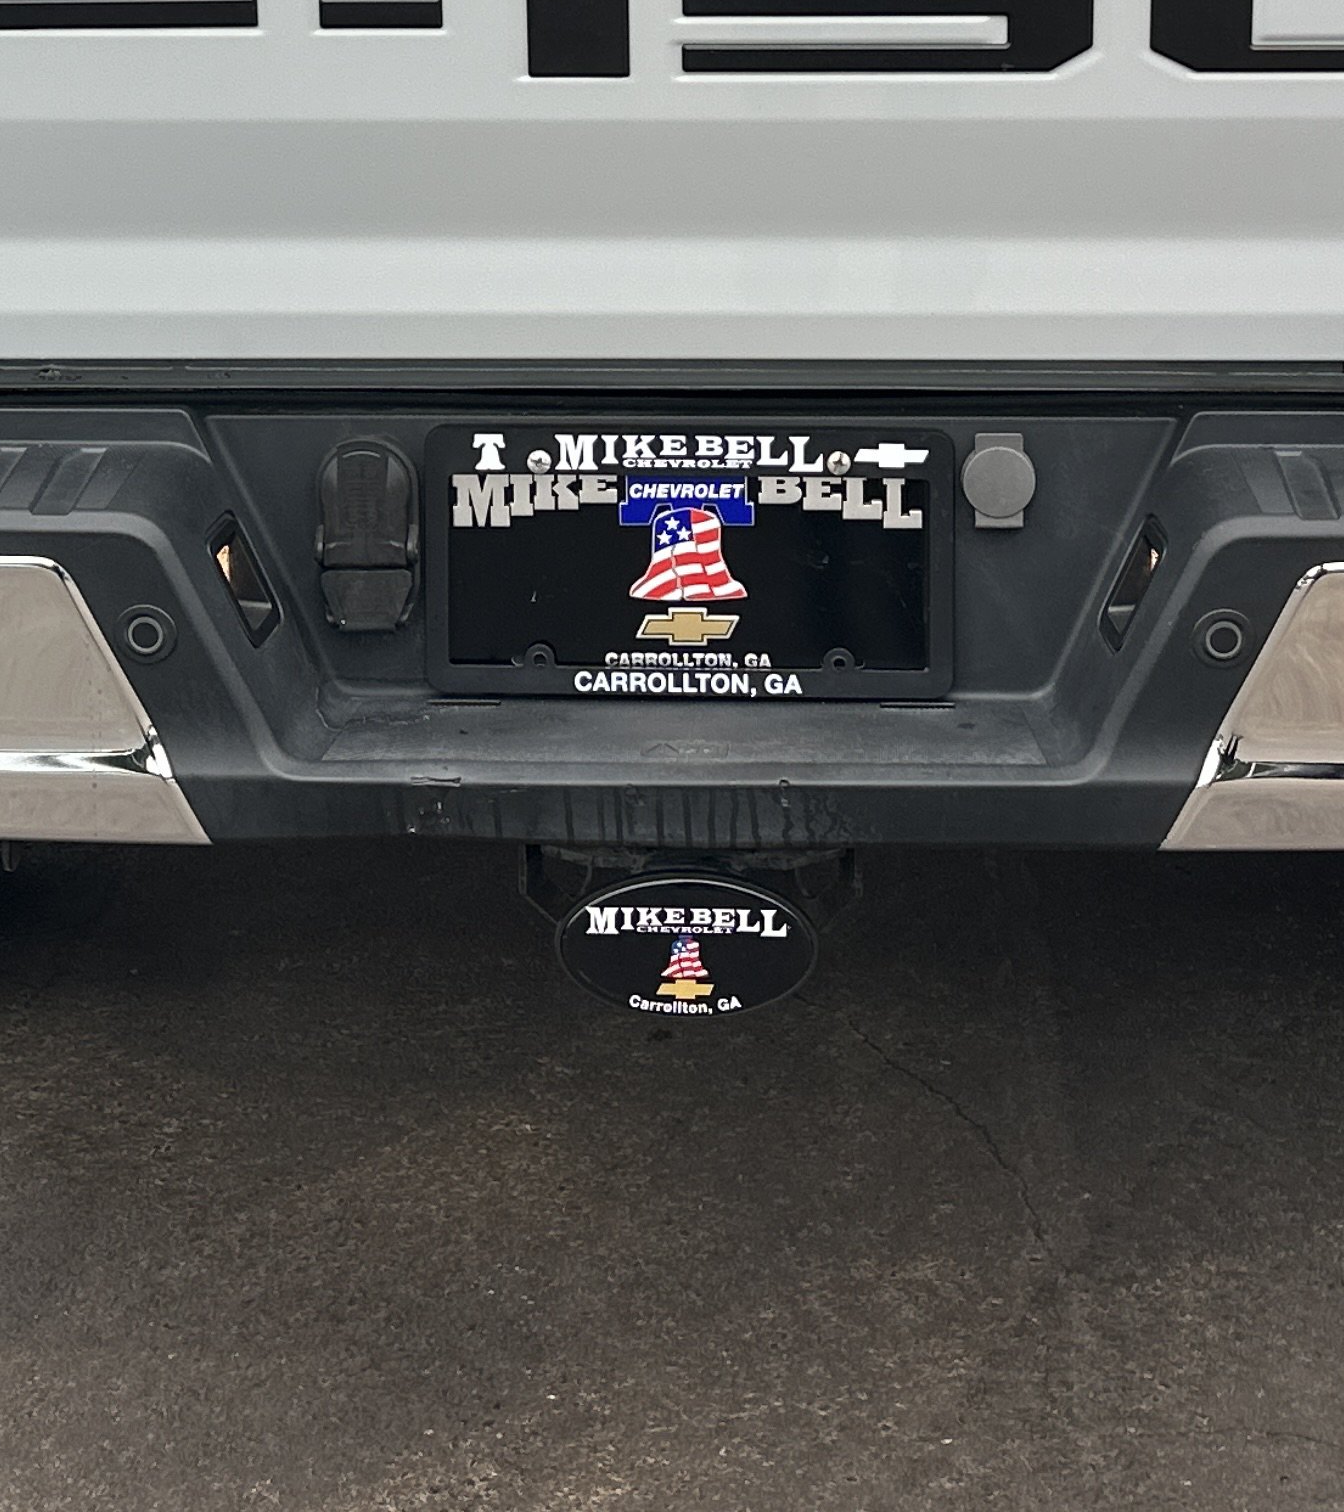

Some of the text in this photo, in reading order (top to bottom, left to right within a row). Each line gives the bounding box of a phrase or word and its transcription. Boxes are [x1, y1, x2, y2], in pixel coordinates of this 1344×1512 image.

[554, 434, 824, 473] MIKE BELL
[622, 458, 753, 469] CHEVROLET
[452, 474, 923, 529] MIKE BELL
[629, 484, 745, 500] CHEVROLET
[605, 652, 772, 669] CARROLLTON, GA
[574, 671, 803, 698] CARROLLTON, GA
[585, 906, 788, 937] MIKE BELL
[636, 926, 733, 934] CHEVROLET
[628, 995, 743, 1014] Carrollton, GA
